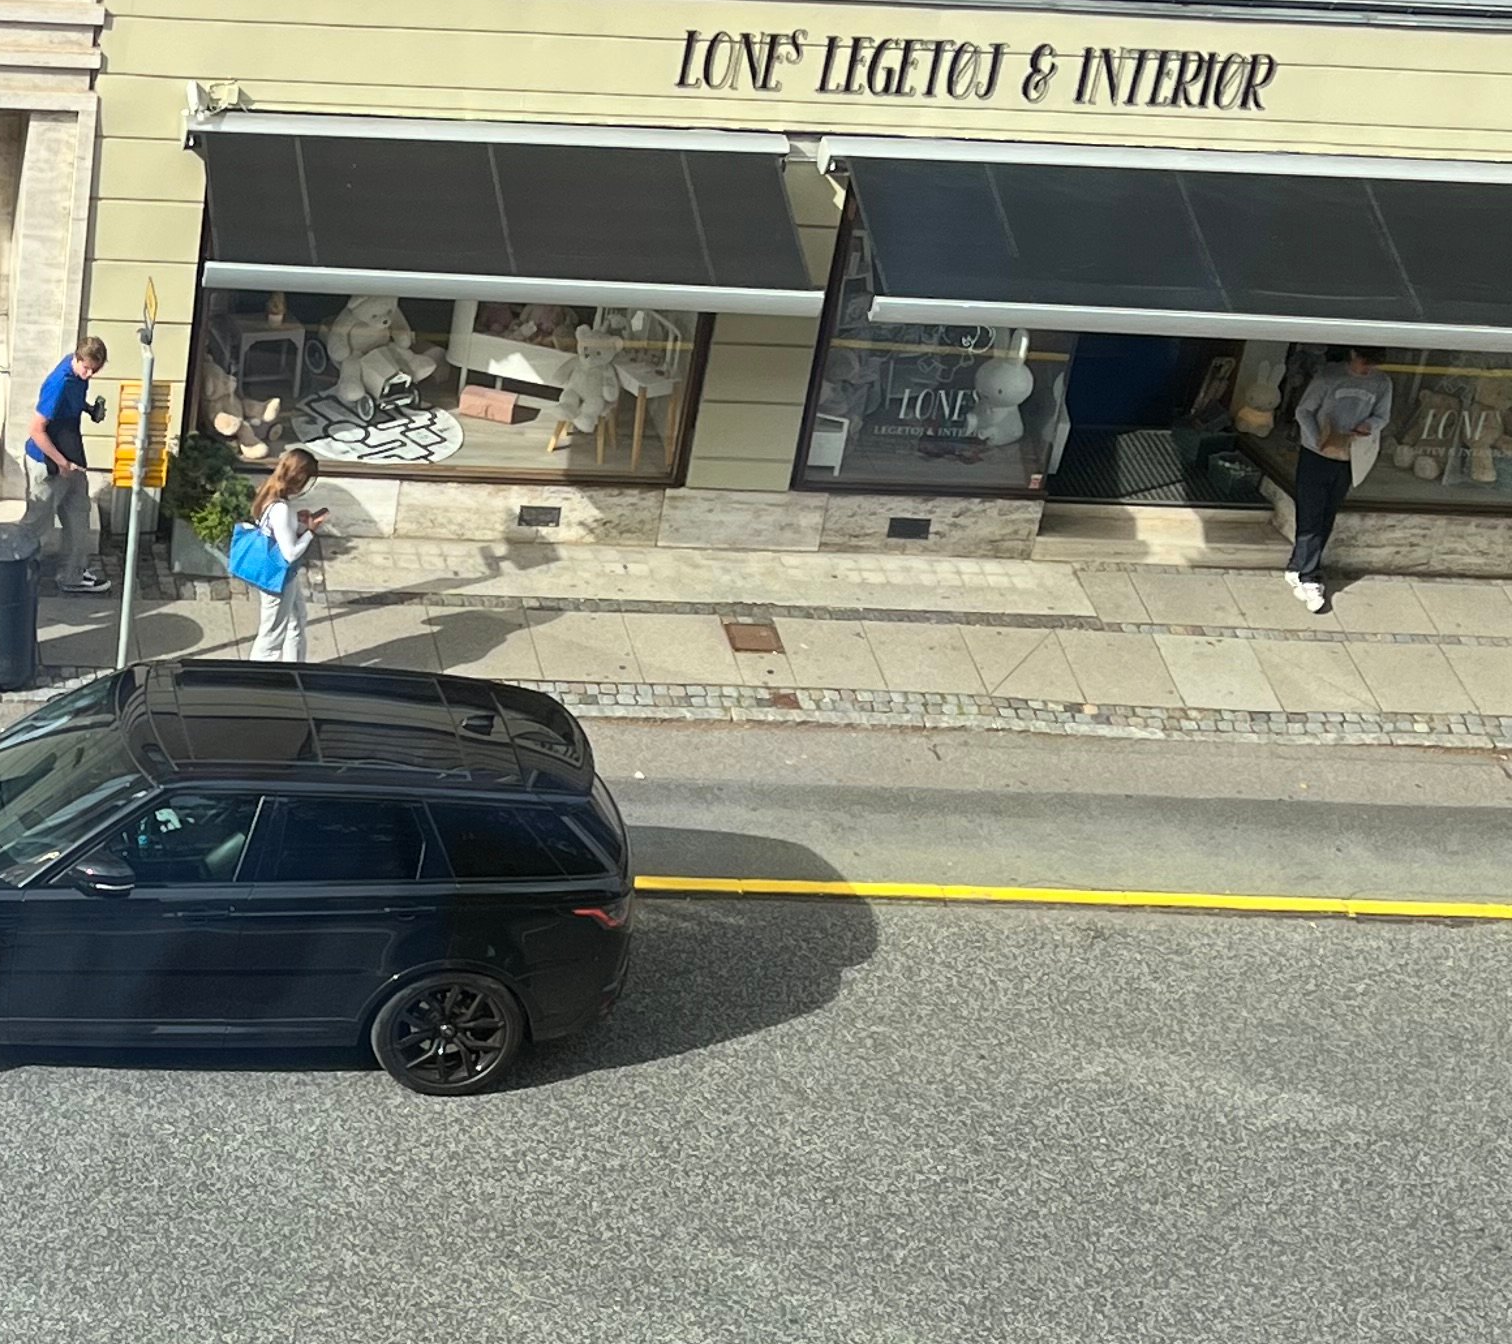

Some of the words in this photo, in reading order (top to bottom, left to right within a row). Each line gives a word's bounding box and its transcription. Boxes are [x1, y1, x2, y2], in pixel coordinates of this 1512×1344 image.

[814, 34, 1011, 101] LEGETØJ
[1021, 42, 1059, 104] &
[1072, 45, 1279, 111] INTERIØR
